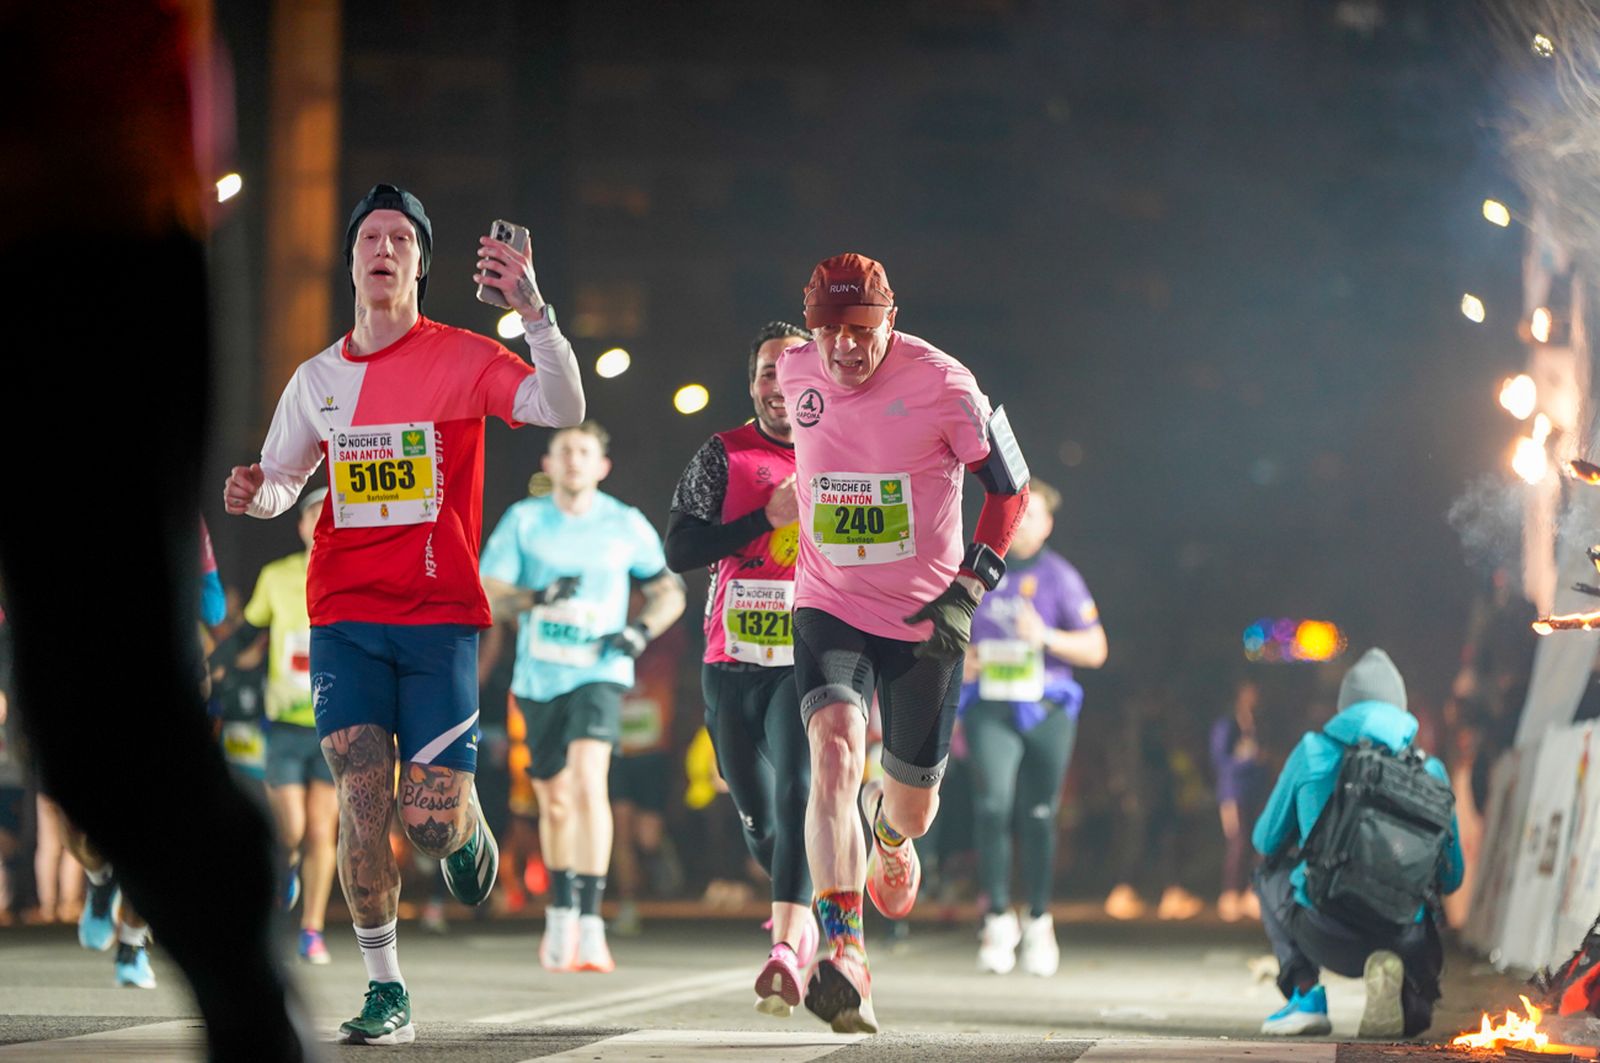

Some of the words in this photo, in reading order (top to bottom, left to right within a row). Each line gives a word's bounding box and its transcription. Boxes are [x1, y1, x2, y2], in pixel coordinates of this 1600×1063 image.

[829, 284, 849, 293] RUN
[348, 436, 378, 448] NOCHE
[380, 436, 393, 446] DE
[339, 450, 358, 461] SAN
[360, 446, 393, 460] ANTÓN
[349, 460, 416, 493] 5163
[831, 482, 858, 492] NOCHE
[860, 483, 872, 492] DE
[820, 493, 838, 504] SAN
[840, 491, 872, 505] ANTÓN
[835, 506, 884, 534] 240
[846, 536, 874, 544] Santiago
[746, 590, 773, 599] NOCHE
[775, 591, 785, 599] DE
[734, 600, 752, 609] SAN
[754, 599, 785, 610] ANTÓN
[737, 611, 793, 637] 1321
[403, 784, 461, 811] Blessed
